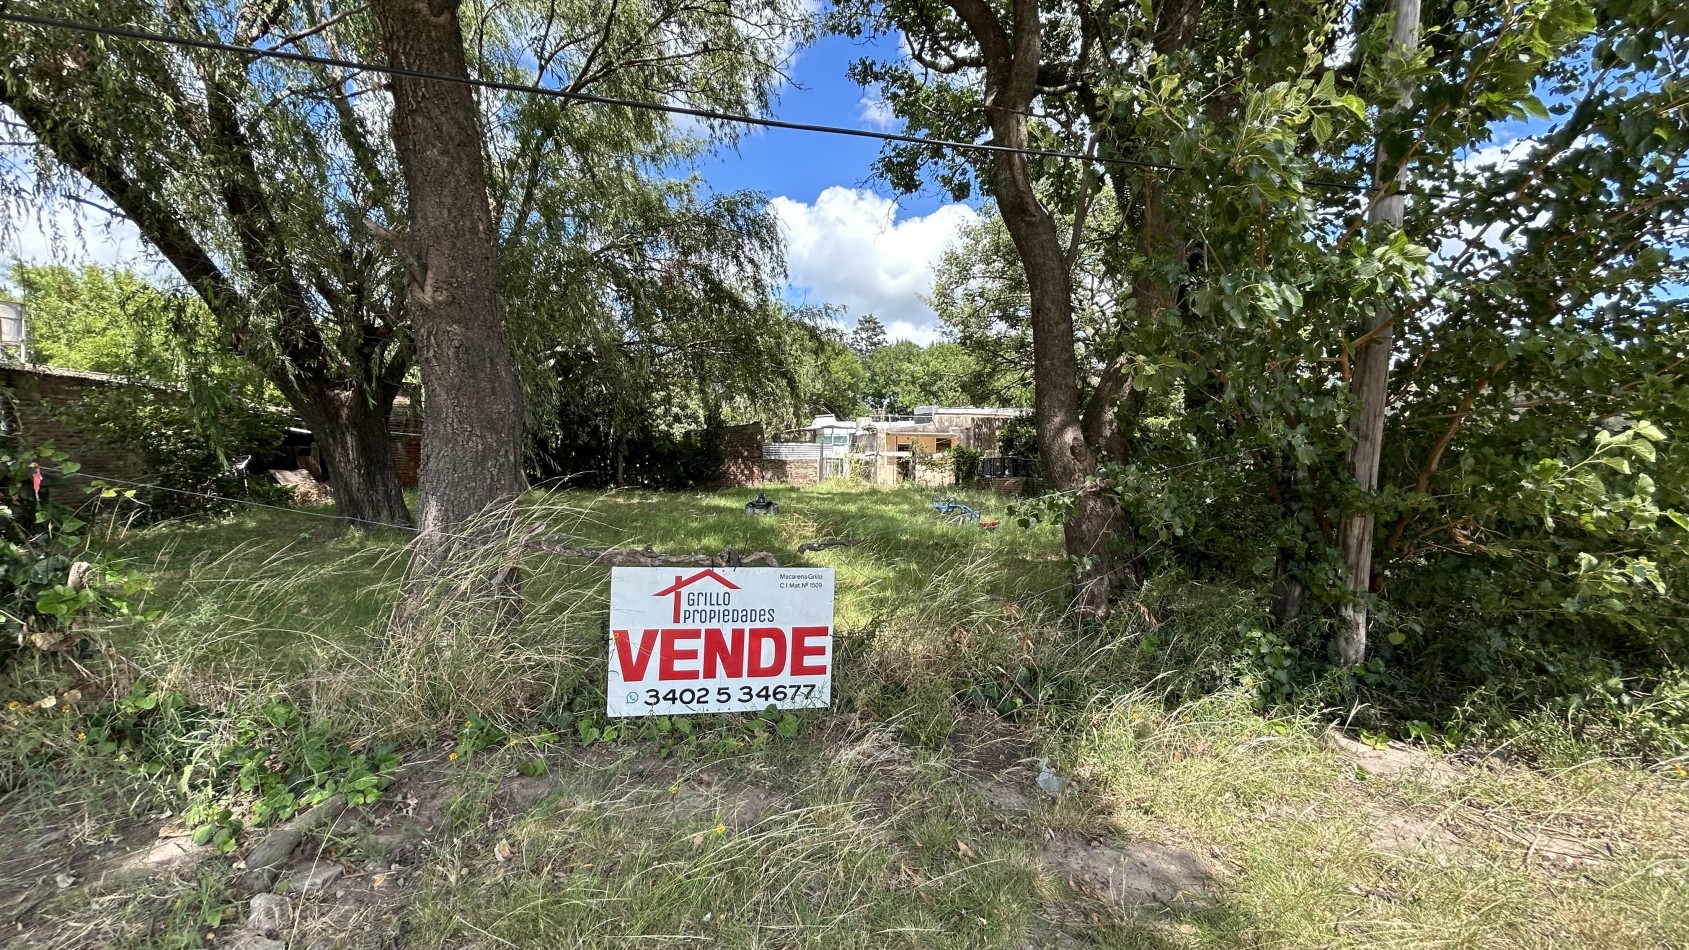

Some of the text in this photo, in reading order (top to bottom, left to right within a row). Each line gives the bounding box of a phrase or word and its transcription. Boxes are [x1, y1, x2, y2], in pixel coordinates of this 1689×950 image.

[613, 626, 829, 682] VENDE
[643, 684, 816, 706] 3402 5 34677
